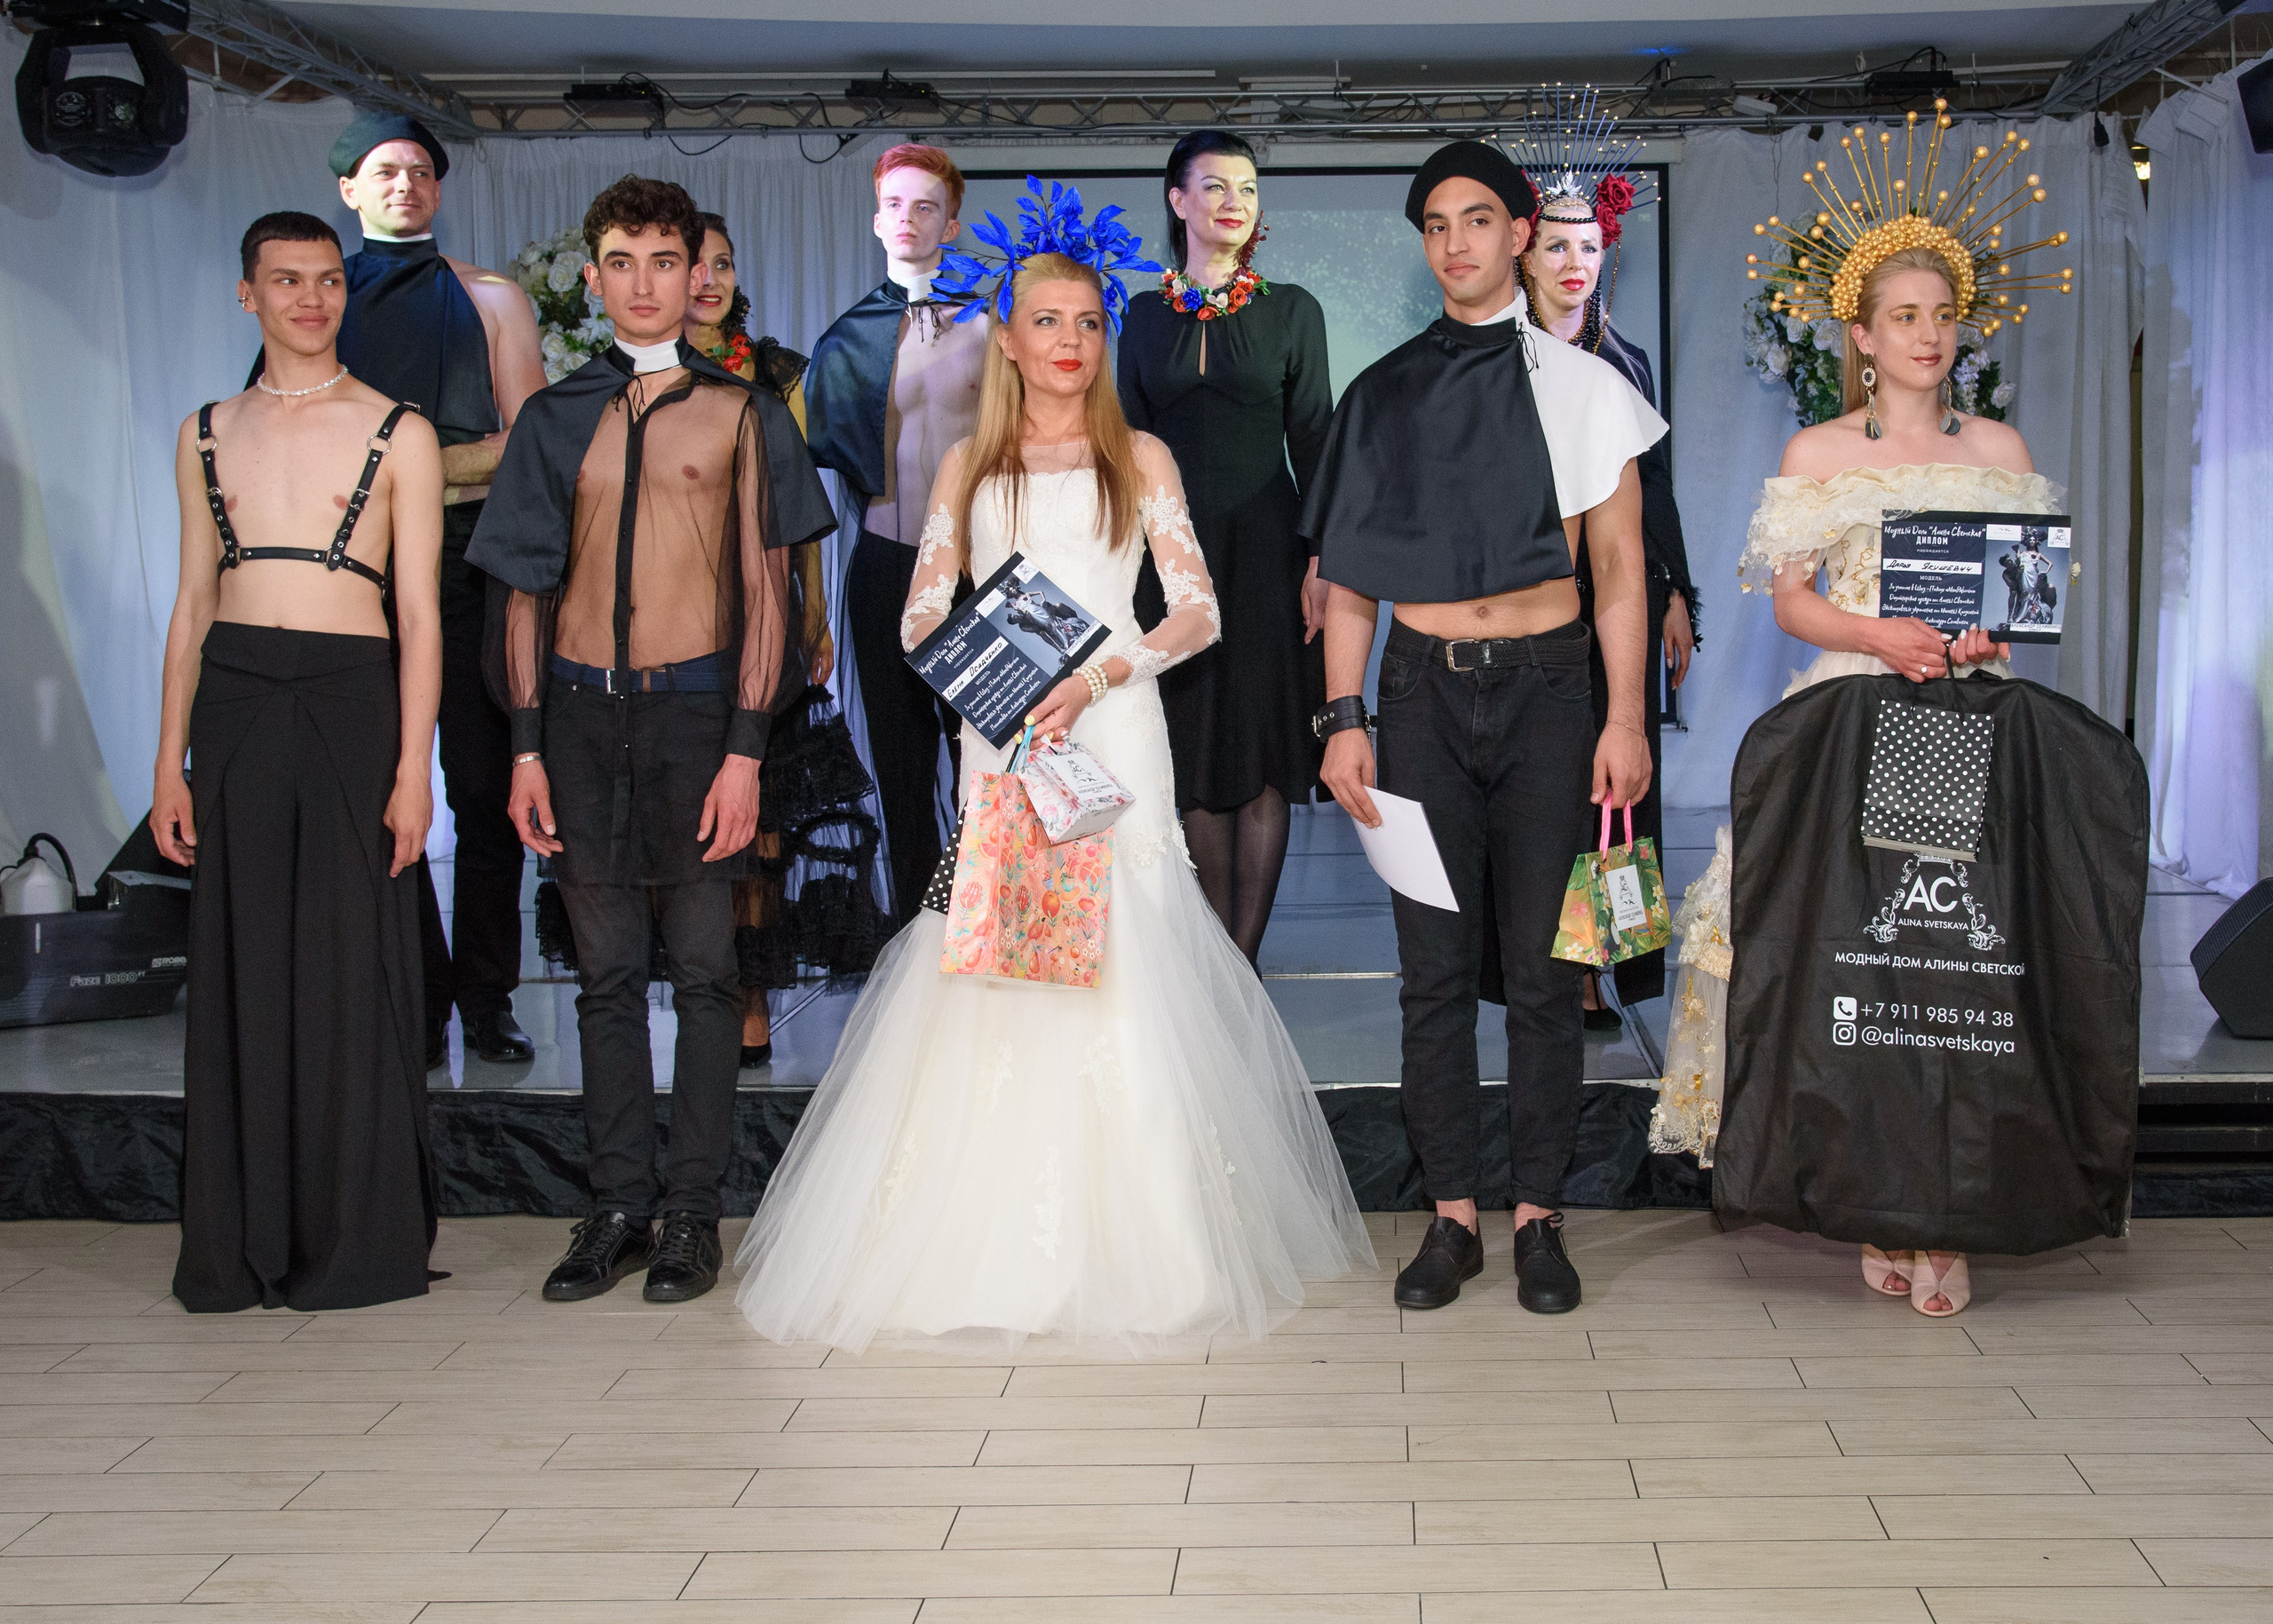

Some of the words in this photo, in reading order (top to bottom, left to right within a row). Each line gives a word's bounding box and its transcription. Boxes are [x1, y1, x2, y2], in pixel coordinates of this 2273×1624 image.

[1884, 526, 1912, 539] Модный
[1912, 525, 1928, 535] Дом
[1928, 526, 1950, 536] "Алина
[1951, 526, 1986, 538] Светская"
[1915, 535, 1948, 545] ДИПЛОМ
[918, 655, 939, 675] Модный
[934, 648, 948, 660] Дом
[944, 640, 968, 664] ДИПЛОМ
[1897, 917, 1922, 927] ALINA
[1924, 920, 1969, 931] SVETSKAYA
[1834, 952, 1889, 965] МОДНЫЙ
[1892, 956, 1921, 969] ДОМ
[1923, 959, 1968, 972] АЛИНЫ
[1972, 963, 2025, 976] СВЕТСКОЙ
[1861, 1002, 1885, 1018] +7
[1890, 1004, 1919, 1019] 911
[1926, 1007, 1959, 1024] 985
[1964, 1010, 1985, 1025] 94
[1992, 1011, 2014, 1026] 38
[1861, 1026, 2015, 1057] @alinasvetskaya
